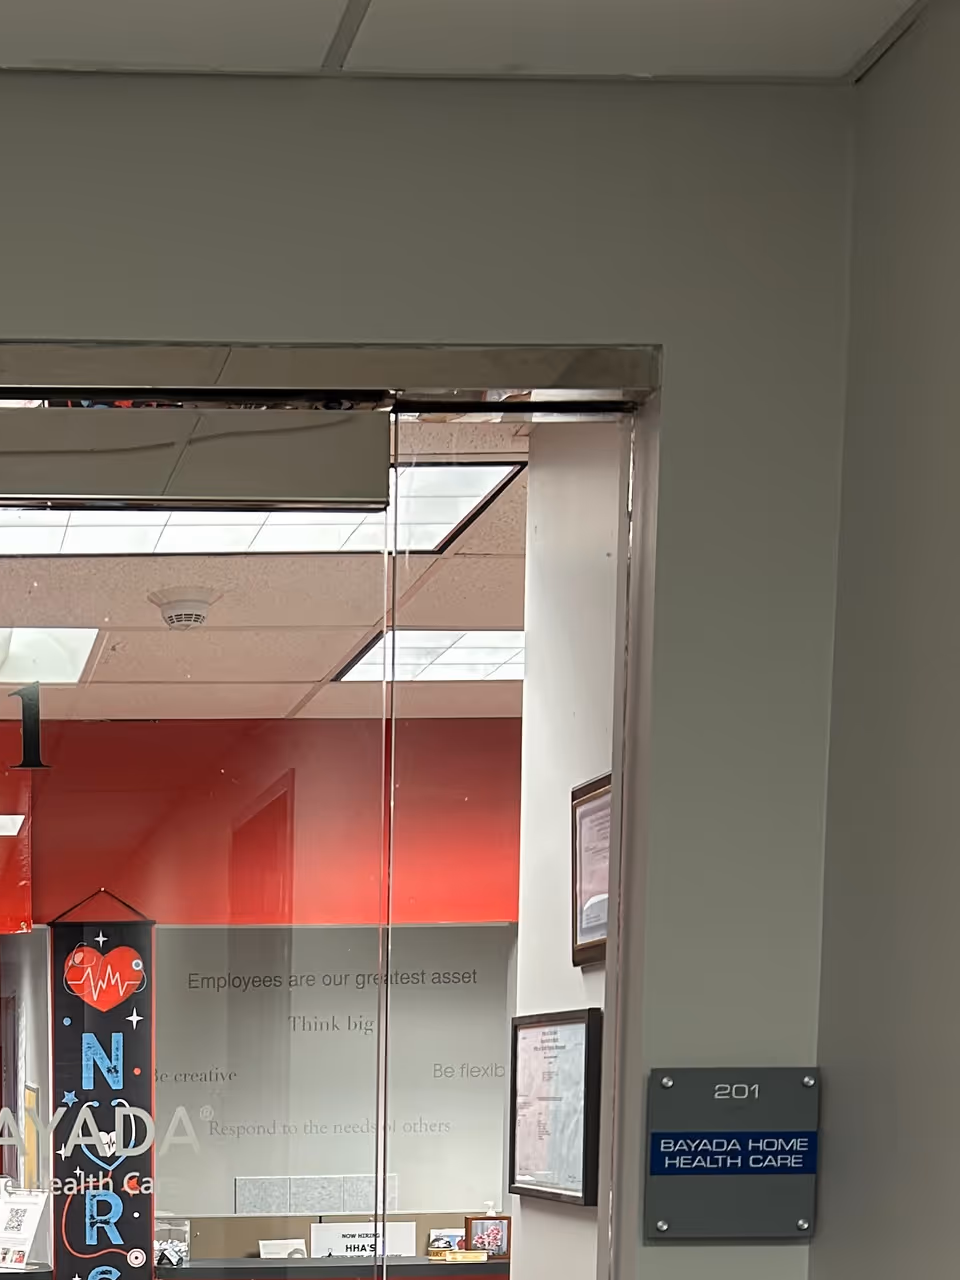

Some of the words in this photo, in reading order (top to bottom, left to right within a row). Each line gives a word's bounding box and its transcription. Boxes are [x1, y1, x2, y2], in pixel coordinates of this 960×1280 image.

[188, 972, 282, 993] Employees
[289, 974, 316, 989] are
[322, 974, 350, 988] our
[355, 969, 426, 991] greatest
[431, 968, 478, 985] asset
[287, 1015, 340, 1033] Think
[347, 1014, 376, 1035] big
[174, 1066, 237, 1083] creative
[433, 1063, 456, 1078] Be
[460, 1062, 506, 1079] flexib
[713, 1083, 759, 1099] 201
[208, 1120, 277, 1137] Respond
[281, 1122, 298, 1136] to
[303, 1119, 328, 1135] the
[332, 1117, 376, 1135] needs
[402, 1115, 451, 1133] others
[660, 1139, 742, 1152] BAYADA
[748, 1138, 809, 1151] HOME
[664, 1155, 742, 1169] HEALTH
[748, 1154, 803, 1168] CARE
[38, 1171, 113, 1196] ealth
[345, 1243, 376, 1253] HHA'S
